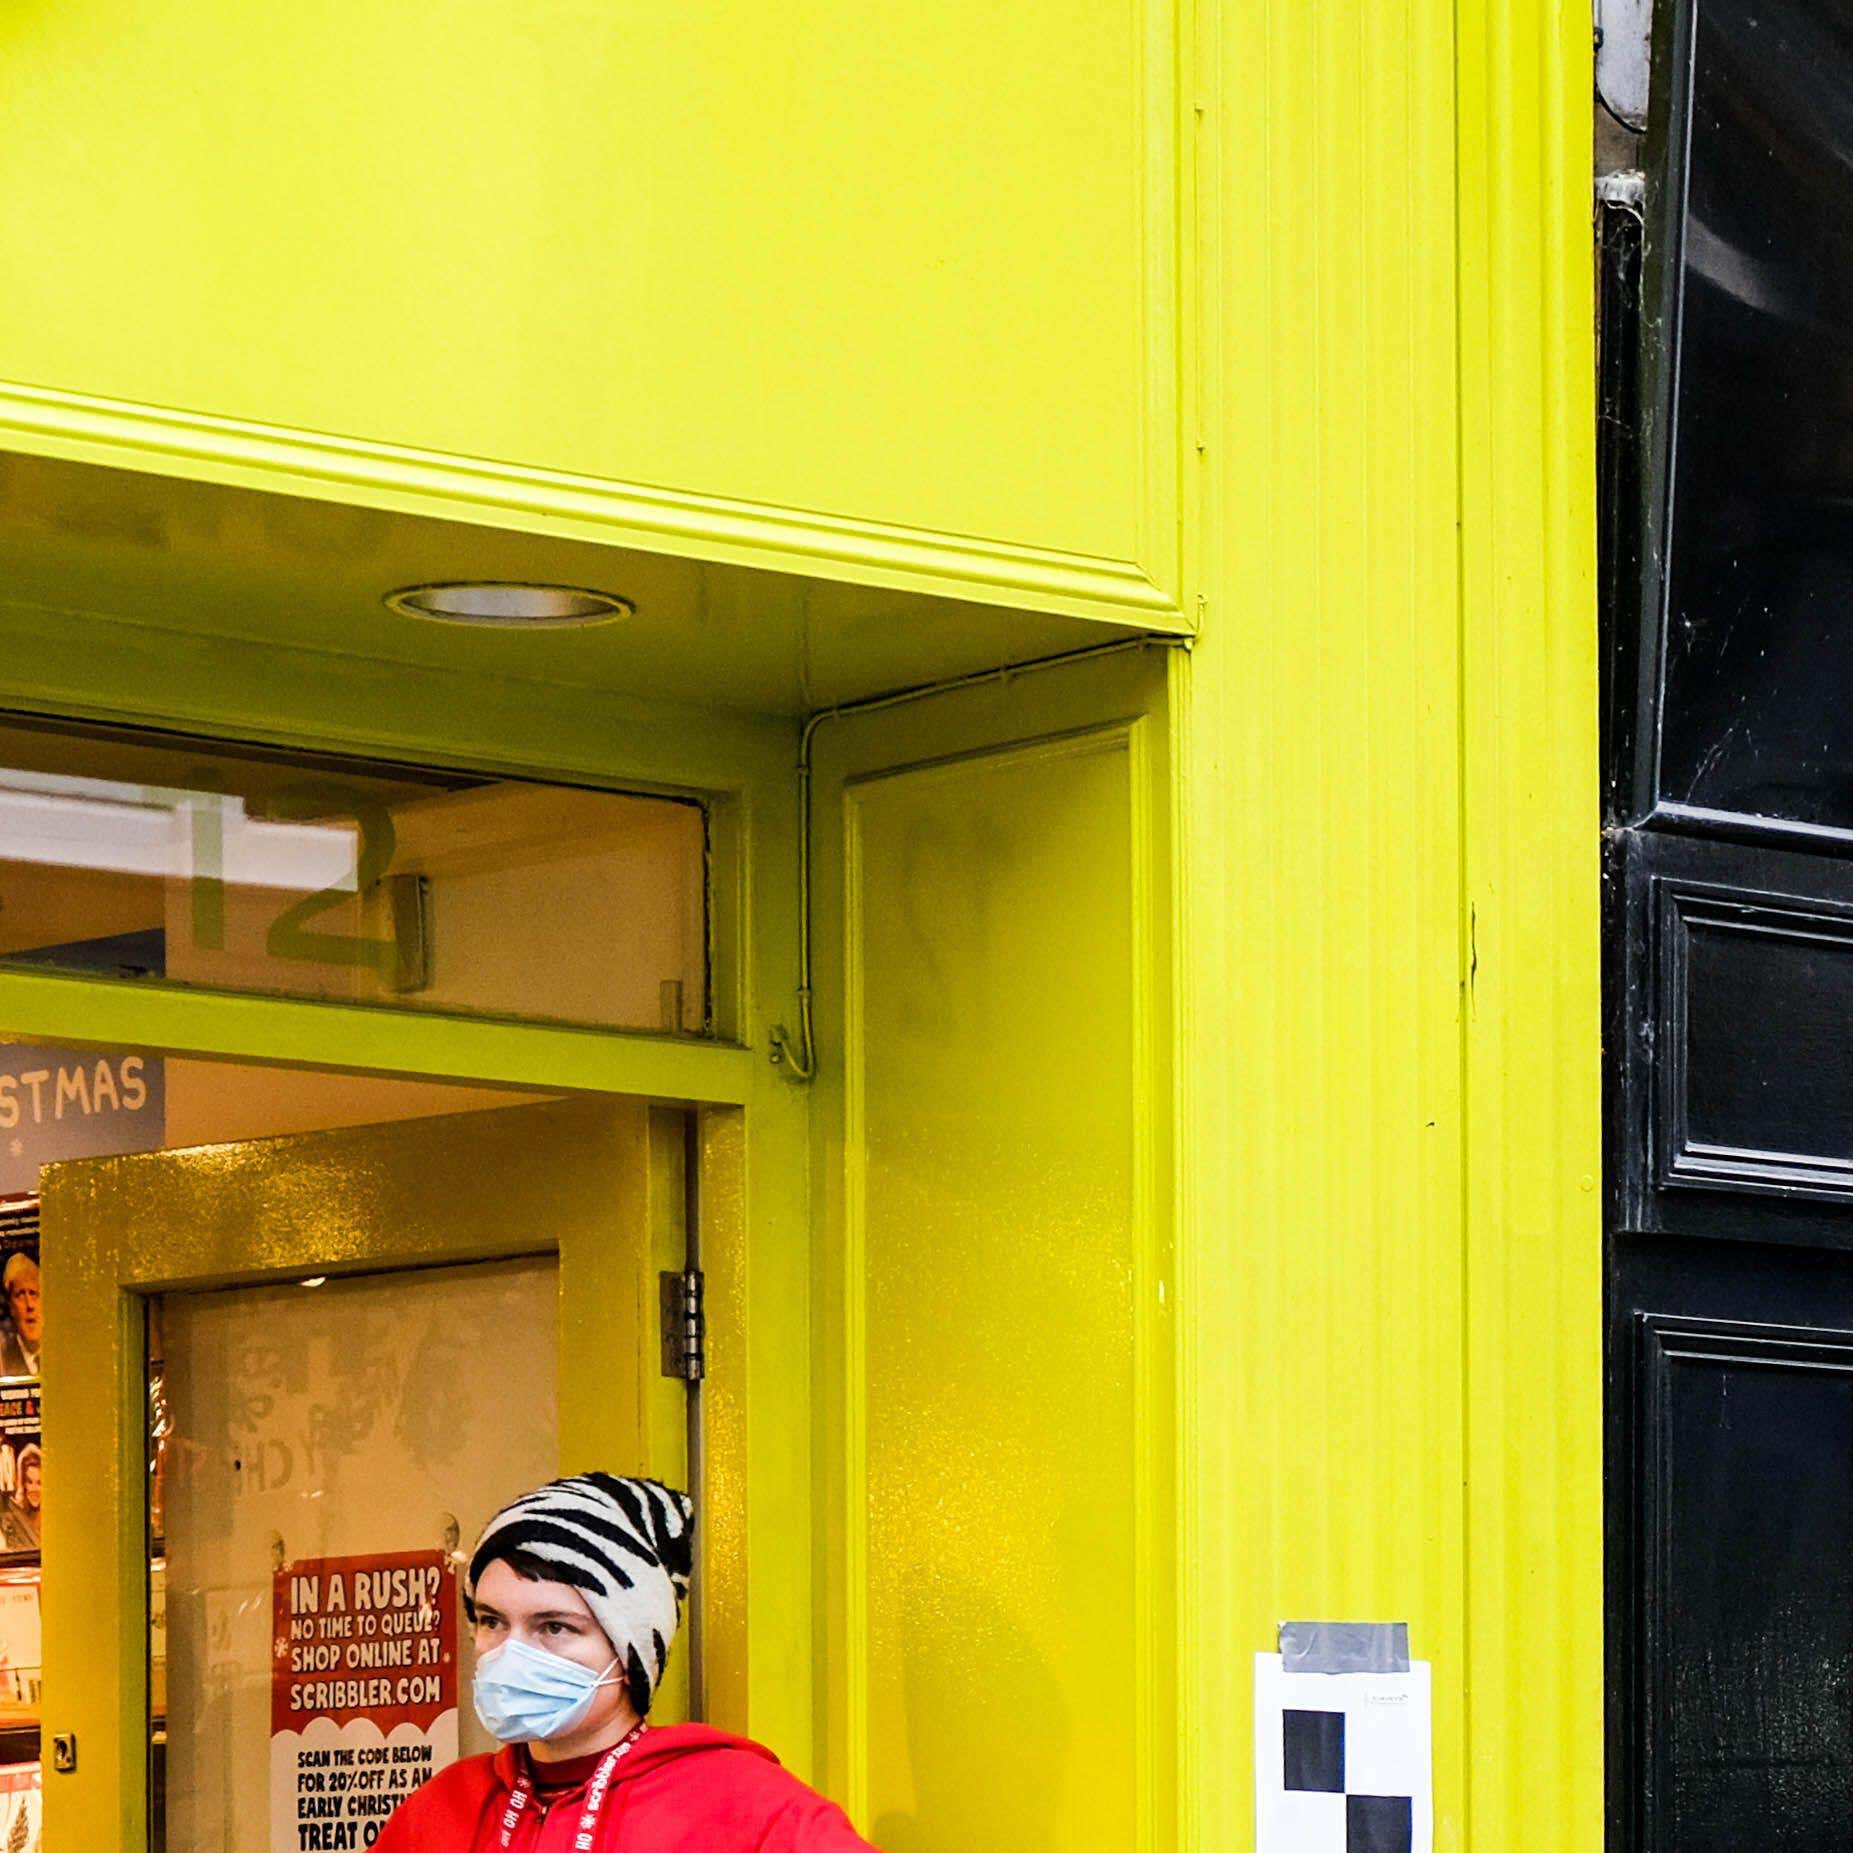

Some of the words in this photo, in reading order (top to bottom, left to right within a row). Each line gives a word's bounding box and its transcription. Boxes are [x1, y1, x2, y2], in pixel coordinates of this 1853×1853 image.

[0, 1056, 147, 1128] STMAS
[290, 1576, 319, 1614] IN
[326, 1574, 346, 1612] A
[354, 1566, 441, 1610] RUSH?
[291, 1618, 314, 1640] NO
[319, 1615, 352, 1639] TIME
[357, 1614, 377, 1636] TO
[381, 1609, 441, 1637] QUEUE?
[291, 1645, 341, 1672] SHOP
[346, 1640, 413, 1669] ONLINE
[417, 1637, 440, 1665] AT
[290, 1675, 441, 1711] SCRIBBLER.COM
[297, 1750, 331, 1768] SCAN
[334, 1749, 354, 1766] THE
[358, 1747, 389, 1765] CODE
[392, 1745, 433, 1764] BELOW
[297, 1773, 325, 1792] FOR
[388, 1768, 407, 1788] AS
[297, 1796, 343, 1819] EARLY
[297, 1821, 358, 1851] TREAT
